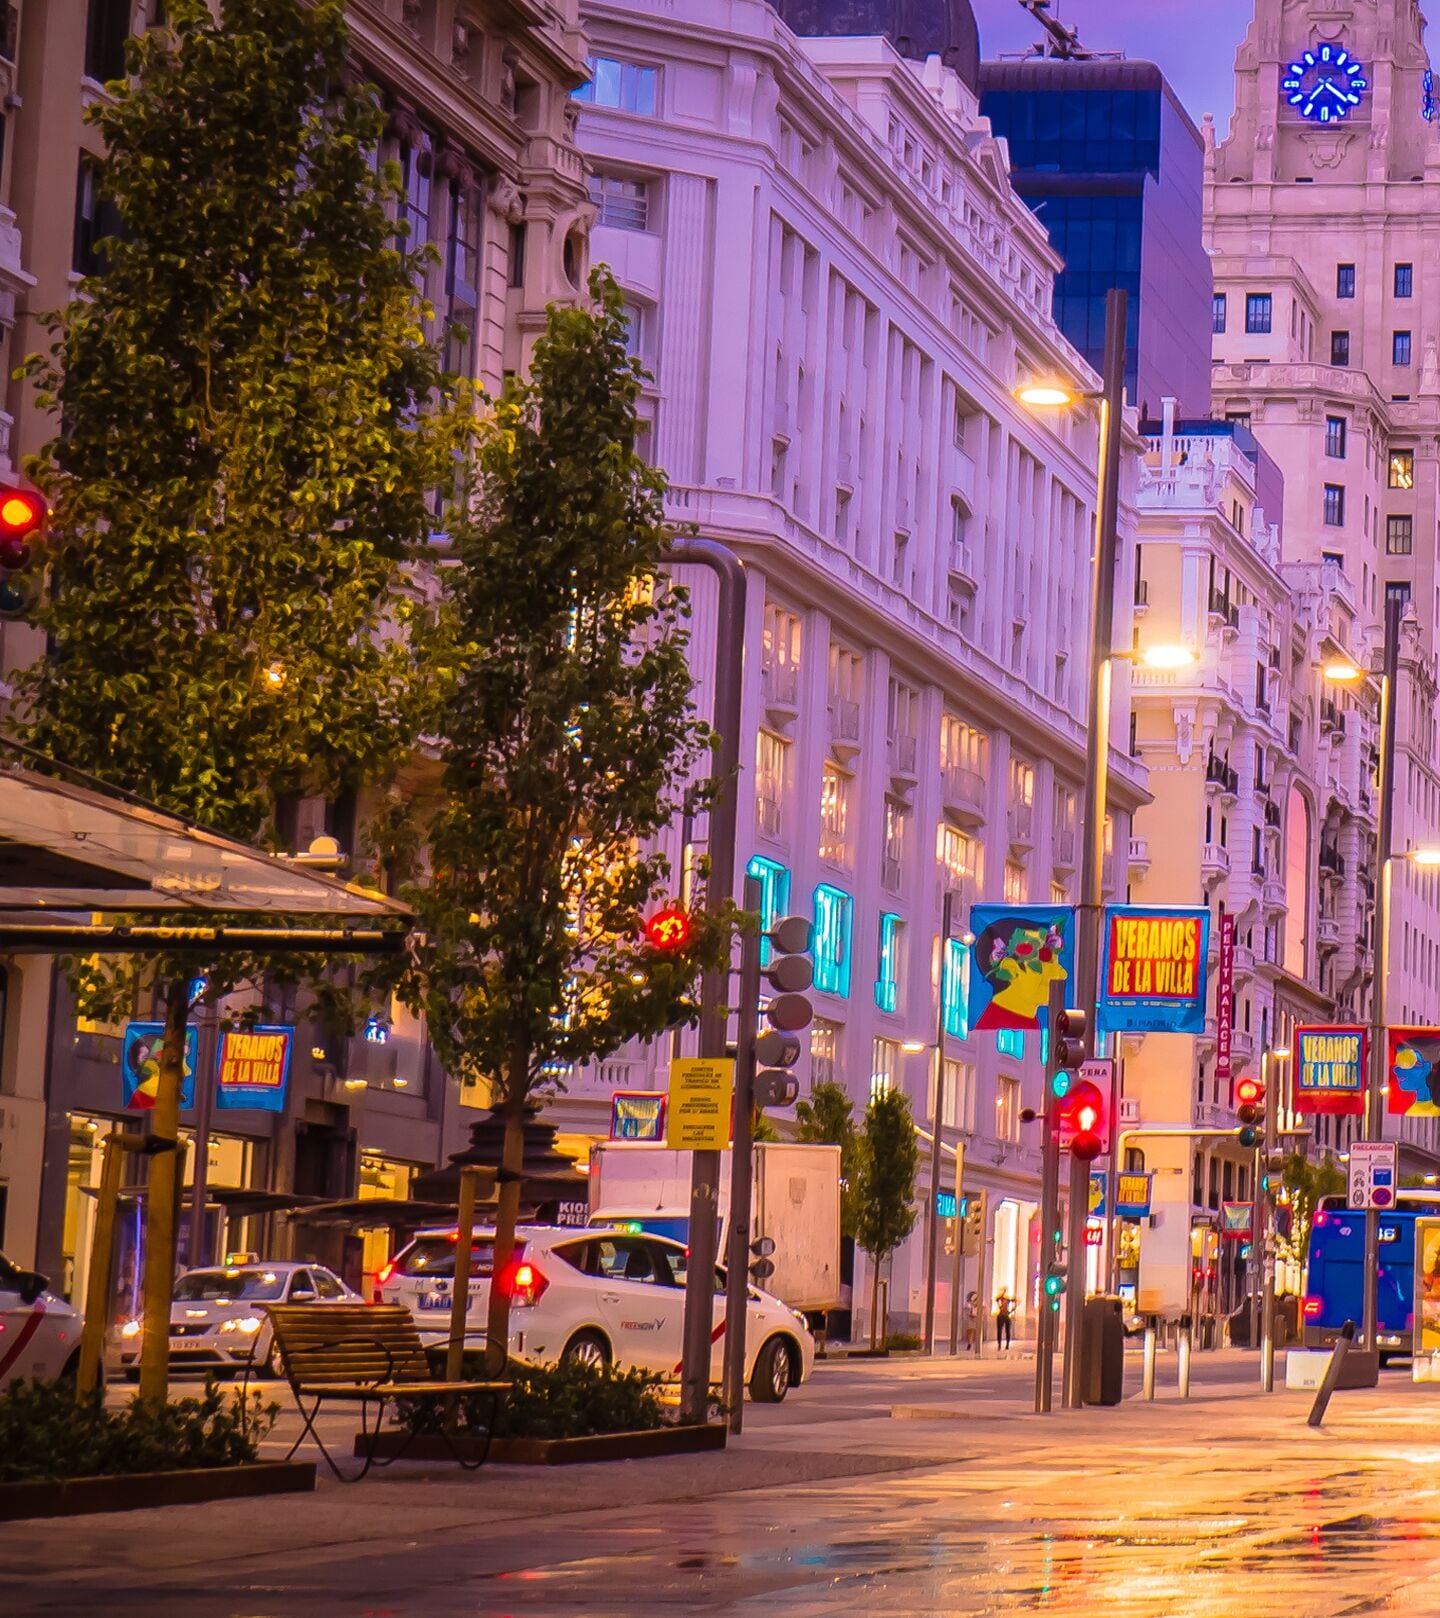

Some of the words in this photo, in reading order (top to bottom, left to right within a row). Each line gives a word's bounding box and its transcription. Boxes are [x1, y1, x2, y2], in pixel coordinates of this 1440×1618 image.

[1116, 919, 1197, 960] VERANOS
[1222, 922, 1232, 979] PETIT
[1112, 961, 1130, 993] DE
[1135, 962, 1151, 993] LA
[1155, 962, 1193, 994] VILLA
[1220, 984, 1230, 1052] PALACE
[226, 1033, 283, 1062] VERANOS
[1303, 1035, 1359, 1063] VERANOS
[223, 1062, 236, 1083] DE
[238, 1062, 250, 1083] LA
[252, 1062, 280, 1085] VILLA
[1303, 1064, 1315, 1086] DE
[1318, 1064, 1330, 1086] LA
[1332, 1064, 1357, 1086] VILLA
